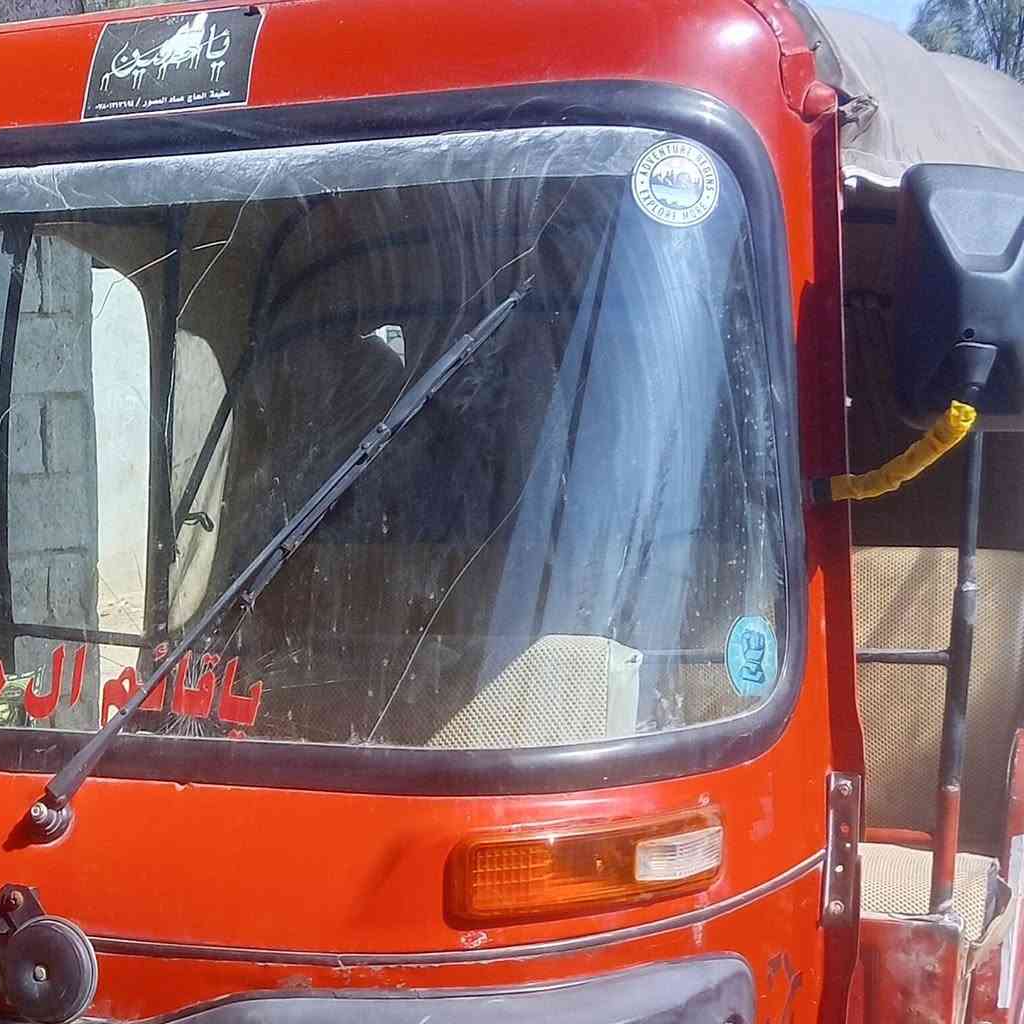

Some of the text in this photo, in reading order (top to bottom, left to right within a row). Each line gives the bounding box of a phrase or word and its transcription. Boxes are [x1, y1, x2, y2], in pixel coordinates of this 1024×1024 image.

[639, 143, 715, 192] ADVENTURE BEGINS
[639, 189, 707, 220] EXPLORE MORE
